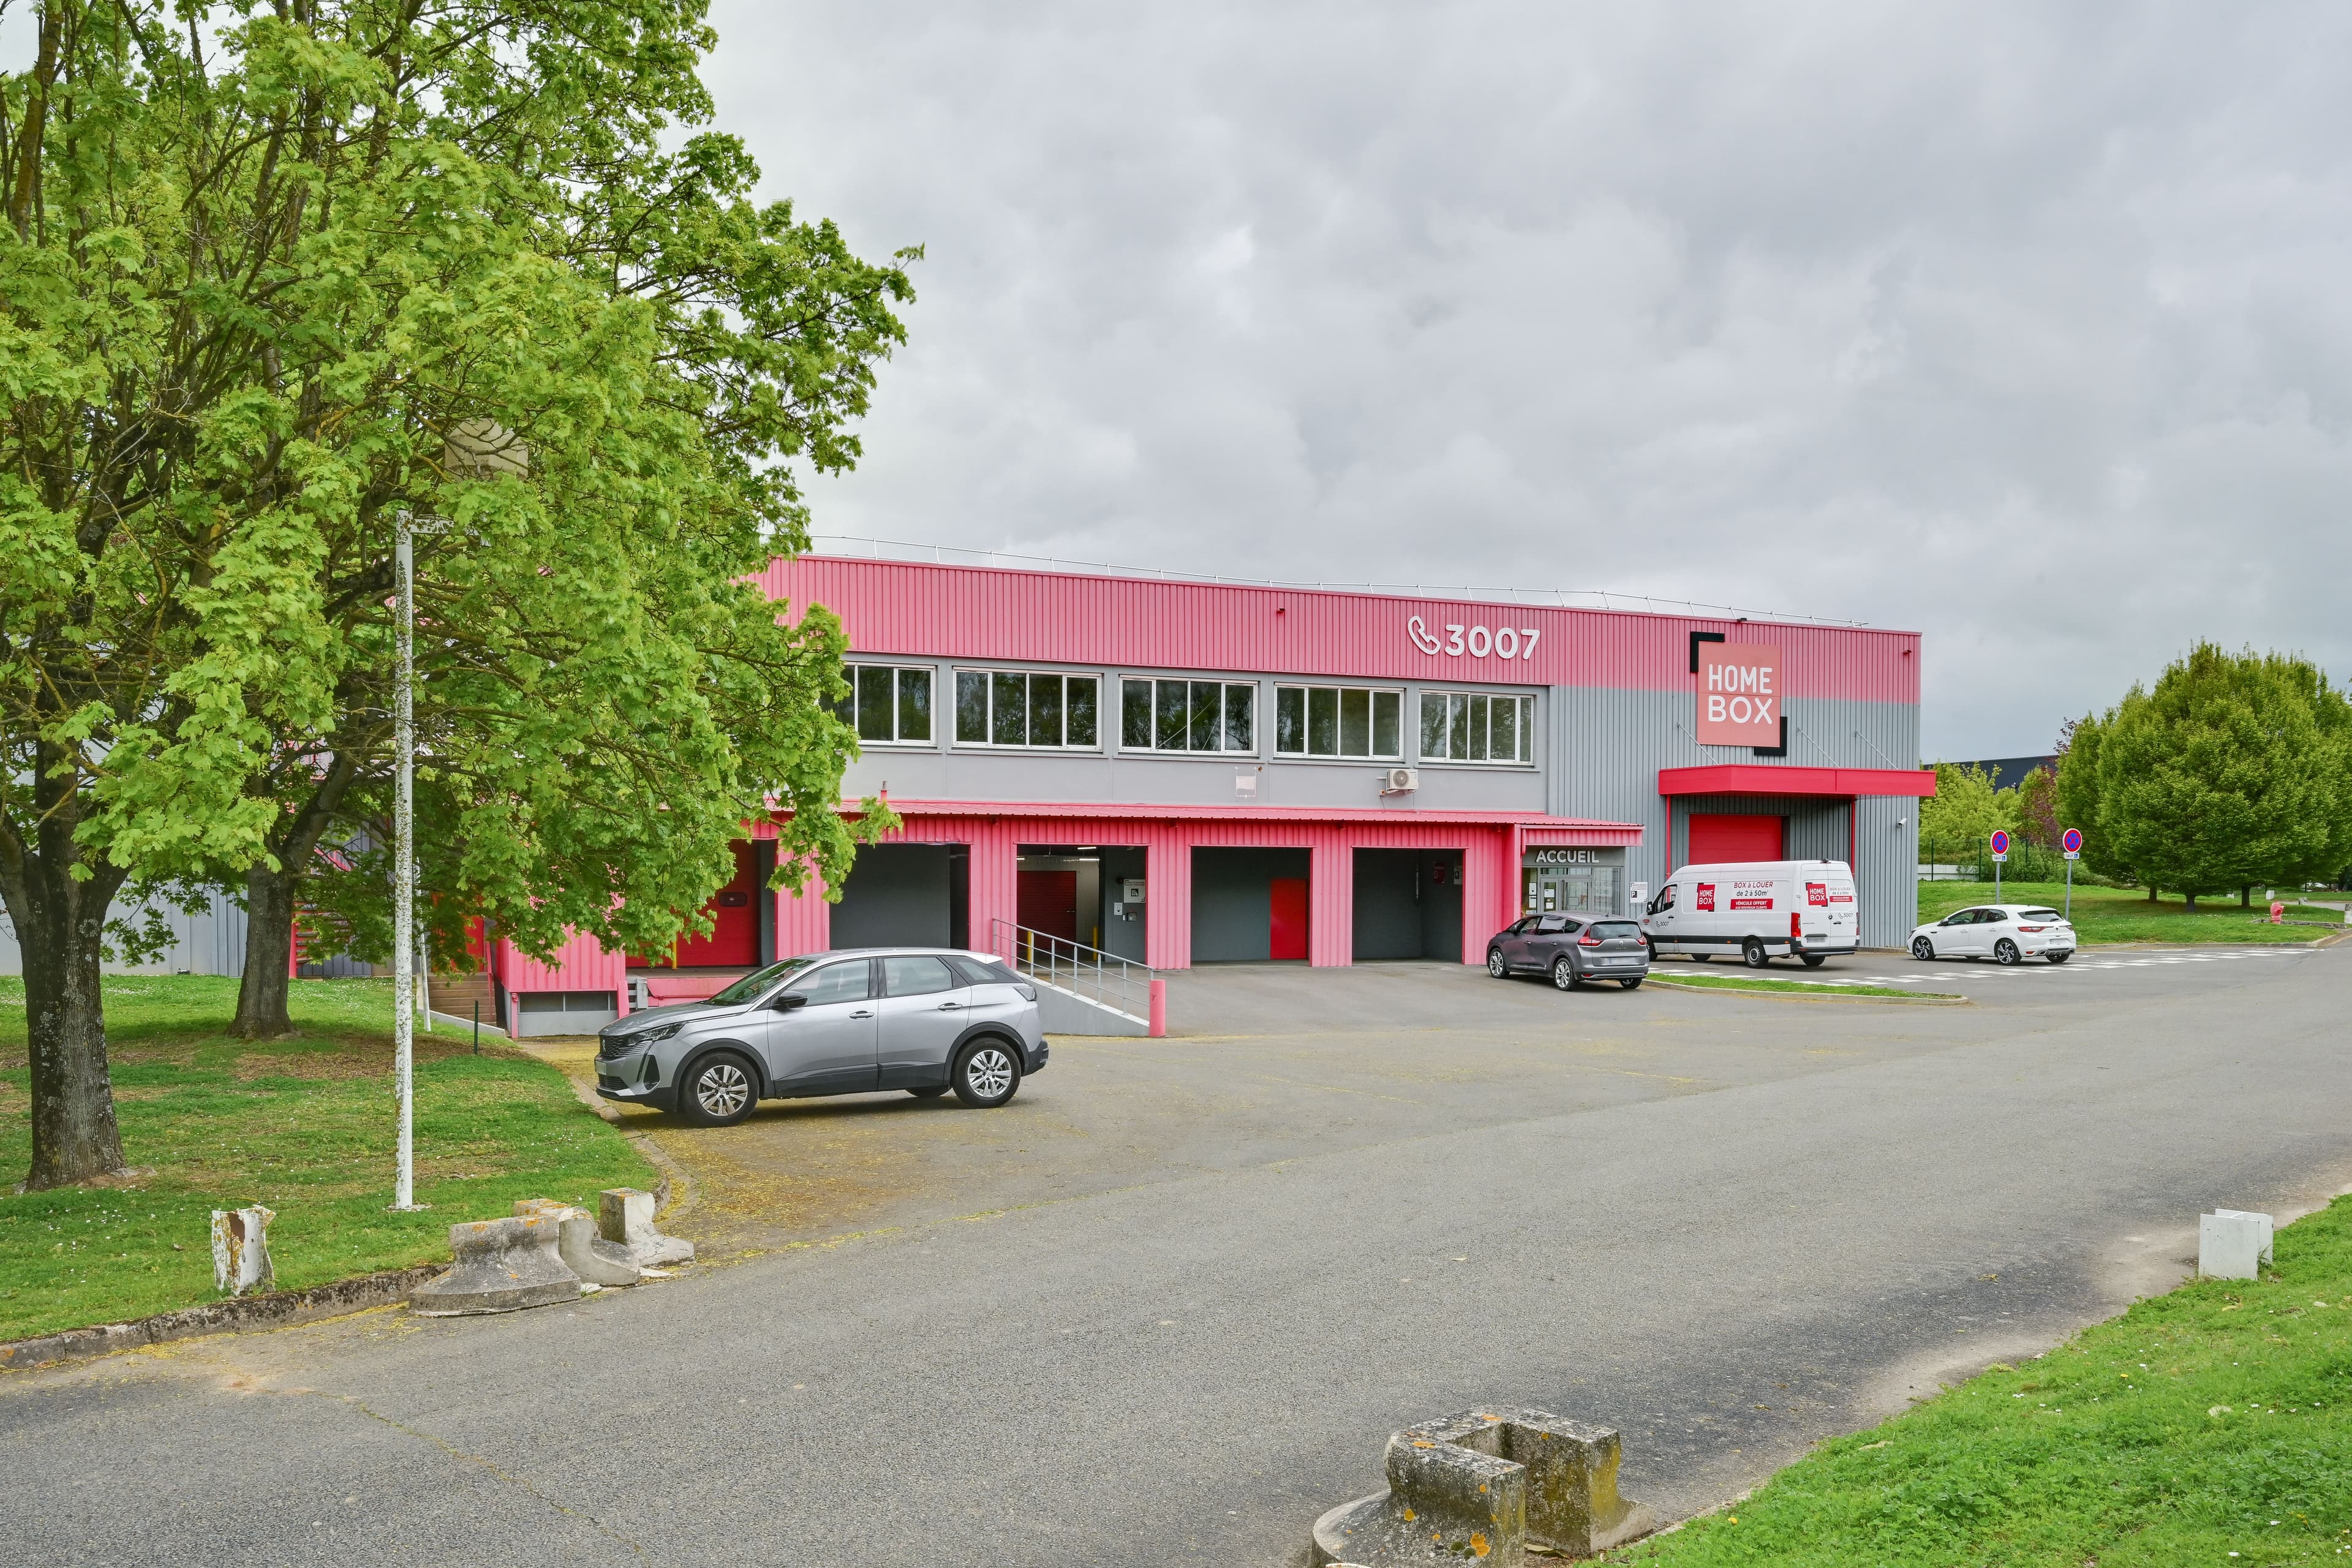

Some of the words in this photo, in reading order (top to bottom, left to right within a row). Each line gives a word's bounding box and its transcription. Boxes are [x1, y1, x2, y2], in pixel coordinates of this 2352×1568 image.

[1445, 624, 1540, 660] 3007
[1708, 663, 1773, 694] HOME
[1708, 695, 1773, 725] BOX
[1536, 850, 1599, 863] ACCUEIL
